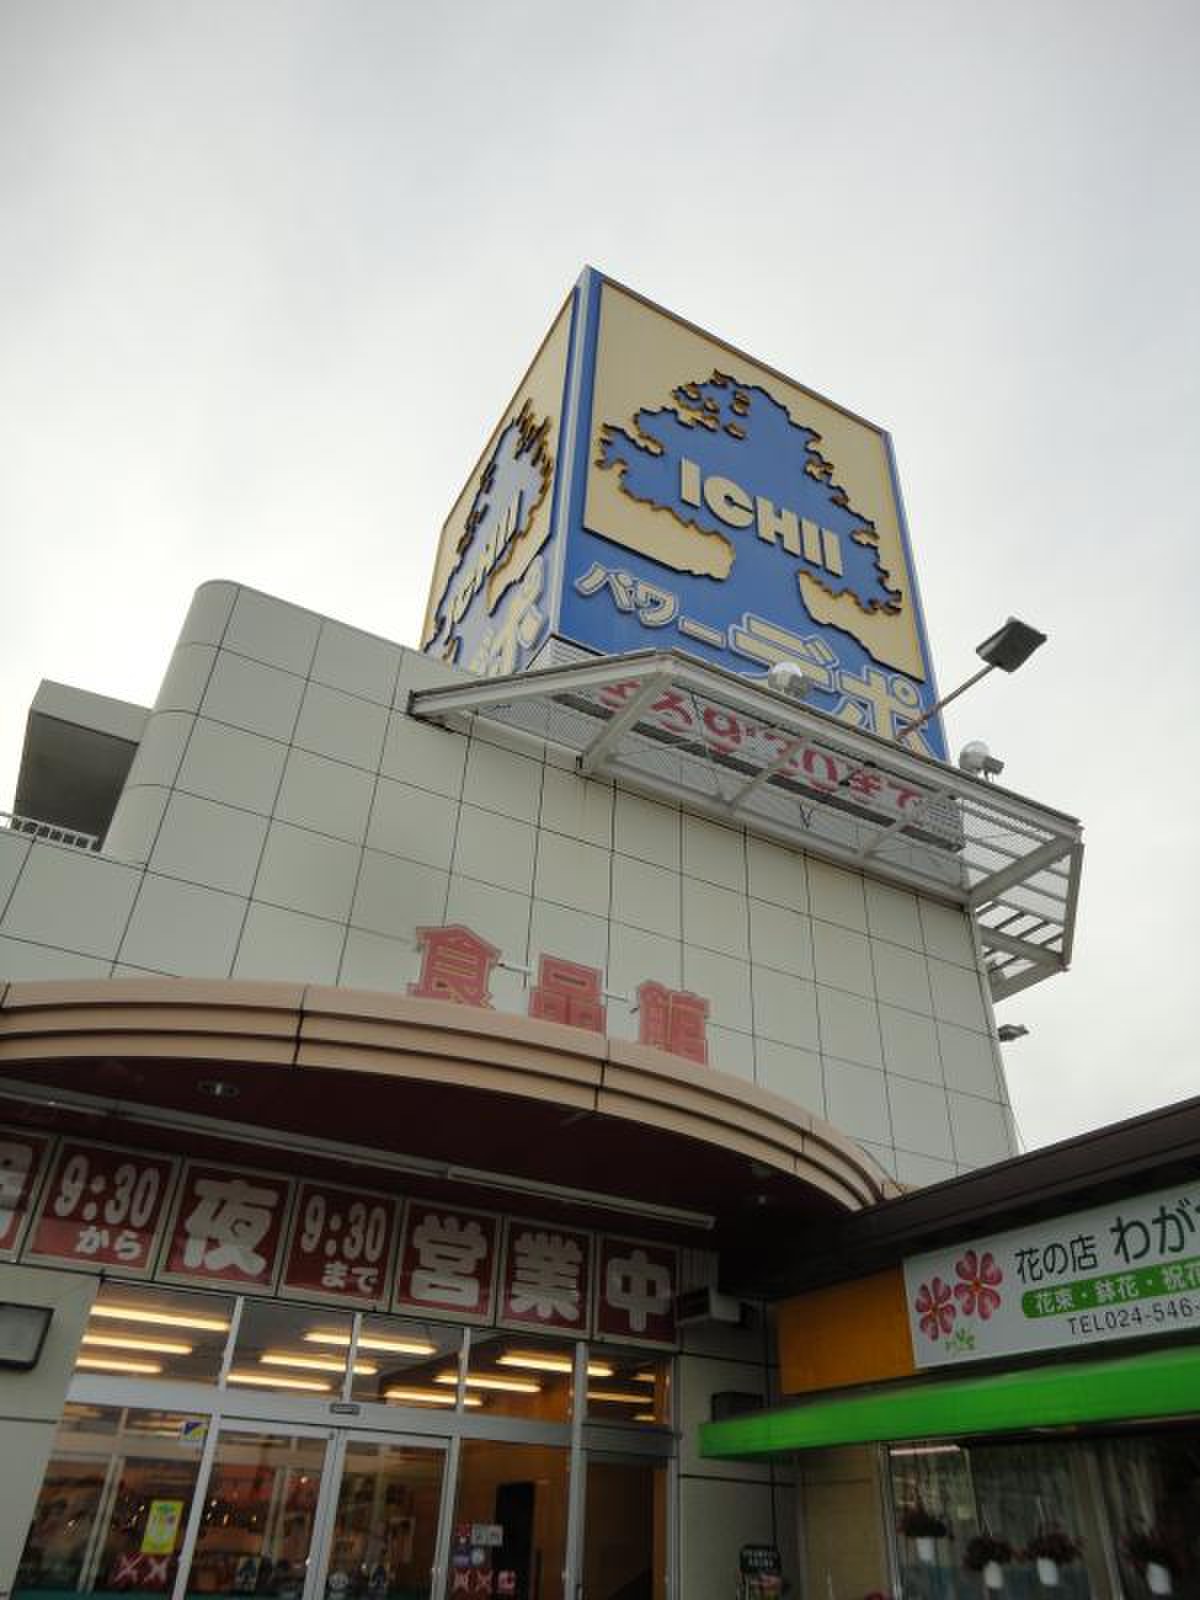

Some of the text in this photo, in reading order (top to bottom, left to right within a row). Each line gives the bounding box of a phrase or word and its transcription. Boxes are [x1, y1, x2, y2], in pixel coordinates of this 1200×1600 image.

[679, 456, 843, 577] ICHII
[54, 1153, 160, 1228] 9:30
[184, 1178, 280, 1276] 夜
[300, 1194, 387, 1262] 9:30
[75, 1225, 142, 1260] から
[321, 1260, 380, 1294] まで
[409, 1214, 672, 1333] 営業中
[1015, 1197, 1200, 1284] 花の店 わが
